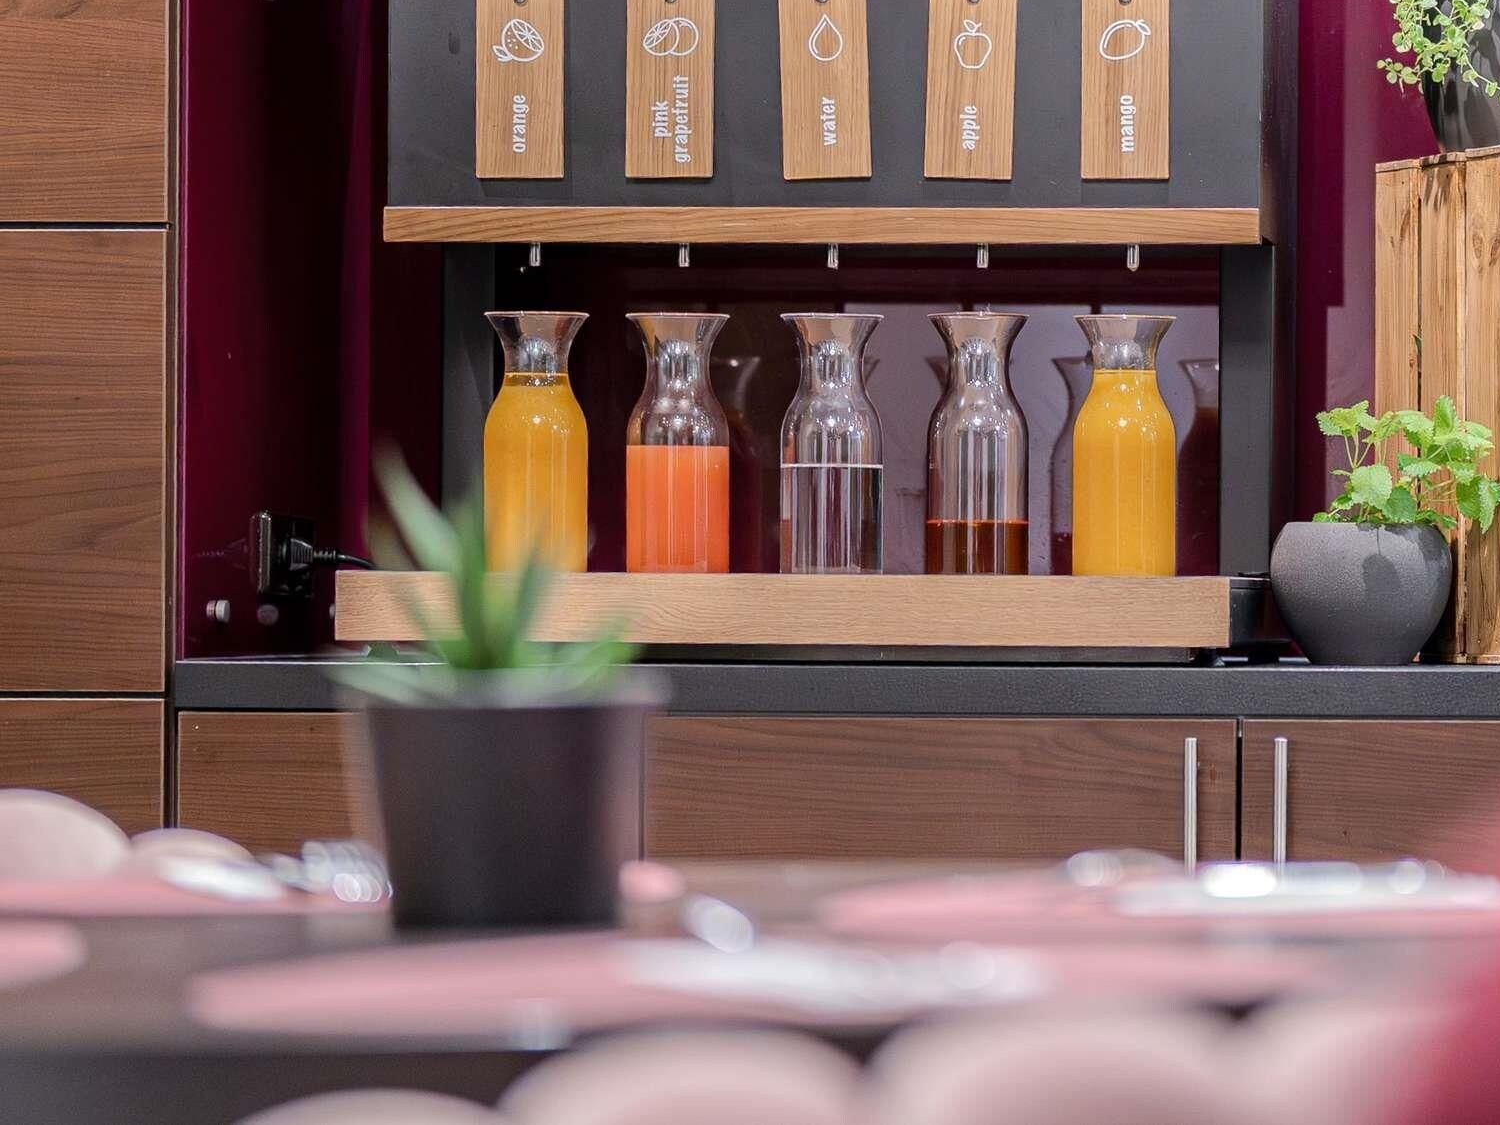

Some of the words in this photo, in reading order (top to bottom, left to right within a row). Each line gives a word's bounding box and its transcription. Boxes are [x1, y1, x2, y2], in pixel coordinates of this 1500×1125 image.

[511, 93, 530, 154] orange
[651, 100, 672, 138] pink
[672, 74, 692, 164] grapefruit
[819, 95, 838, 147] water
[959, 104, 980, 151] apple
[1119, 93, 1137, 154] mango
